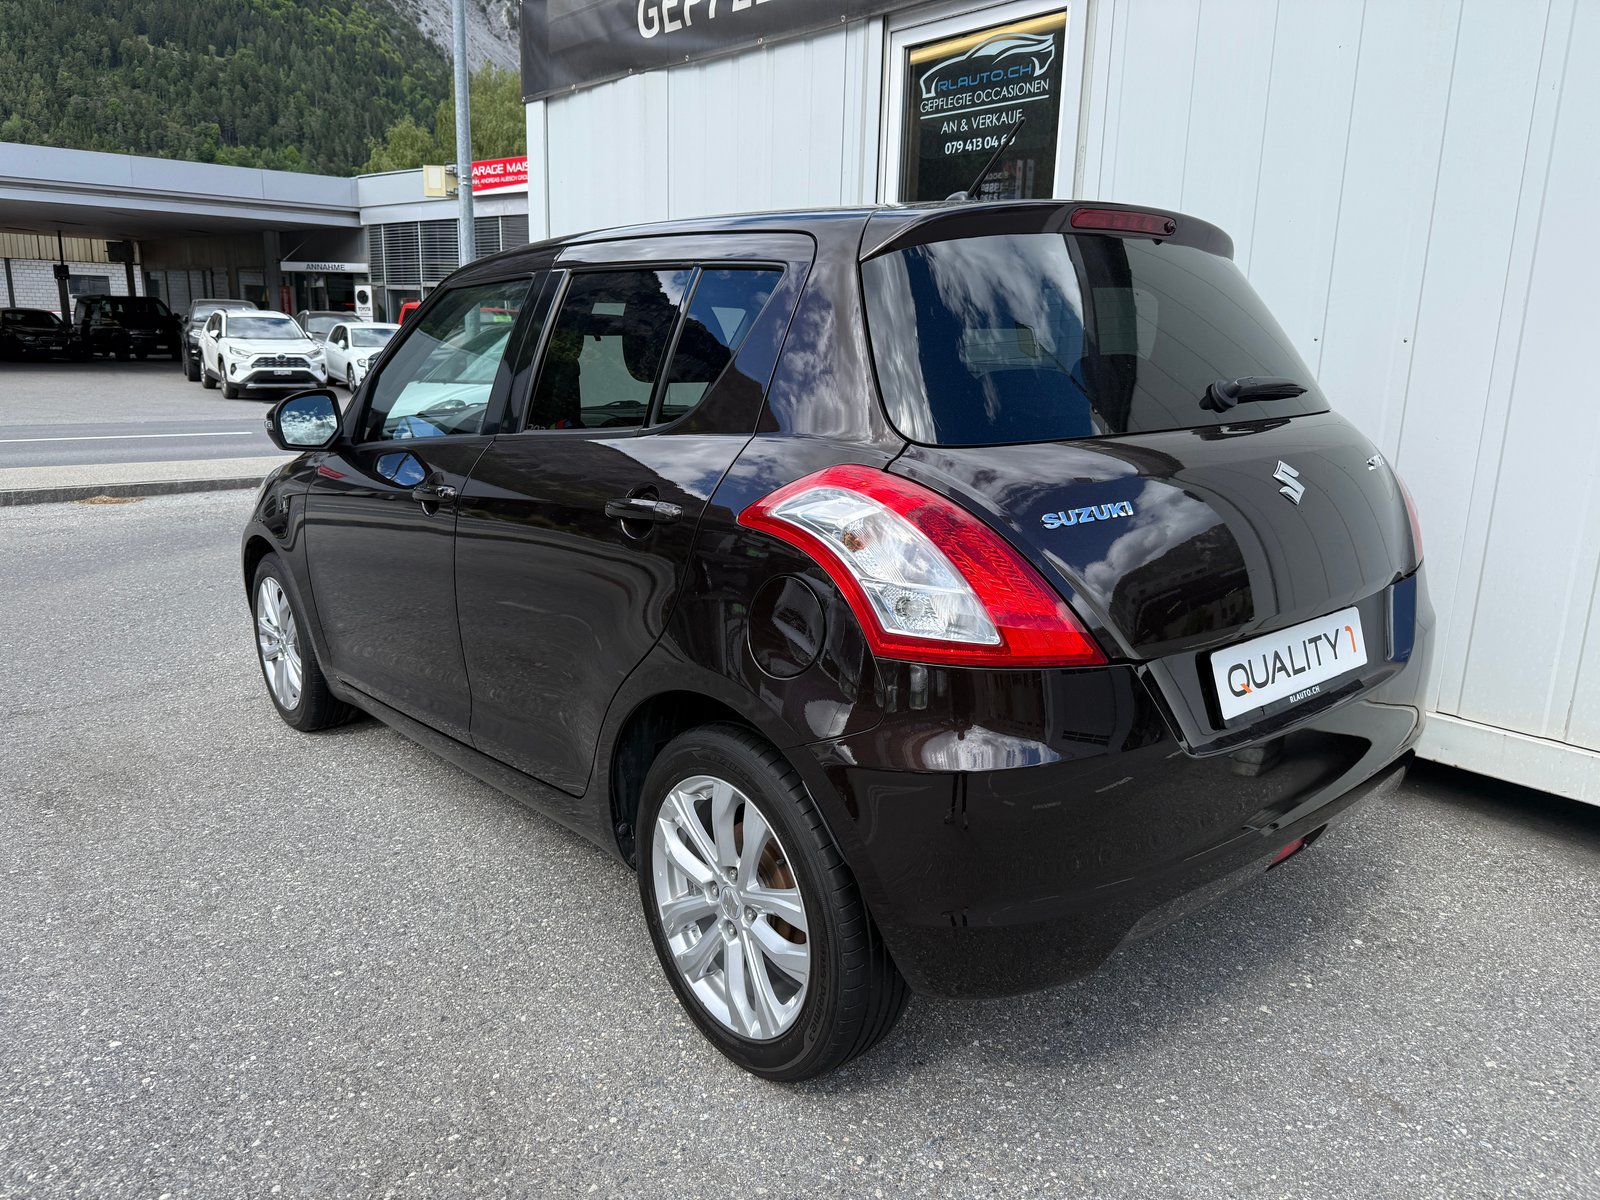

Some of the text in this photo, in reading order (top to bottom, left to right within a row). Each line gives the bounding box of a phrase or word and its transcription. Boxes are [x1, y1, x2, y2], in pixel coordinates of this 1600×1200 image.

[937, 63, 1032, 92] RLAUTO.CH
[920, 78, 1050, 113] GEPFLEGTE OCCASIONEN
[940, 109, 1023, 135] AN & VERKAUF
[944, 140, 964, 155] 079
[965, 138, 983, 152] 413
[984, 135, 999, 149] 04
[306, 263, 346, 272] ANNAHME
[1041, 501, 1134, 530] SUZUKI
[1227, 625, 1357, 698] QUALITY 1
[1289, 685, 1321, 704] RLAUTO.CH
